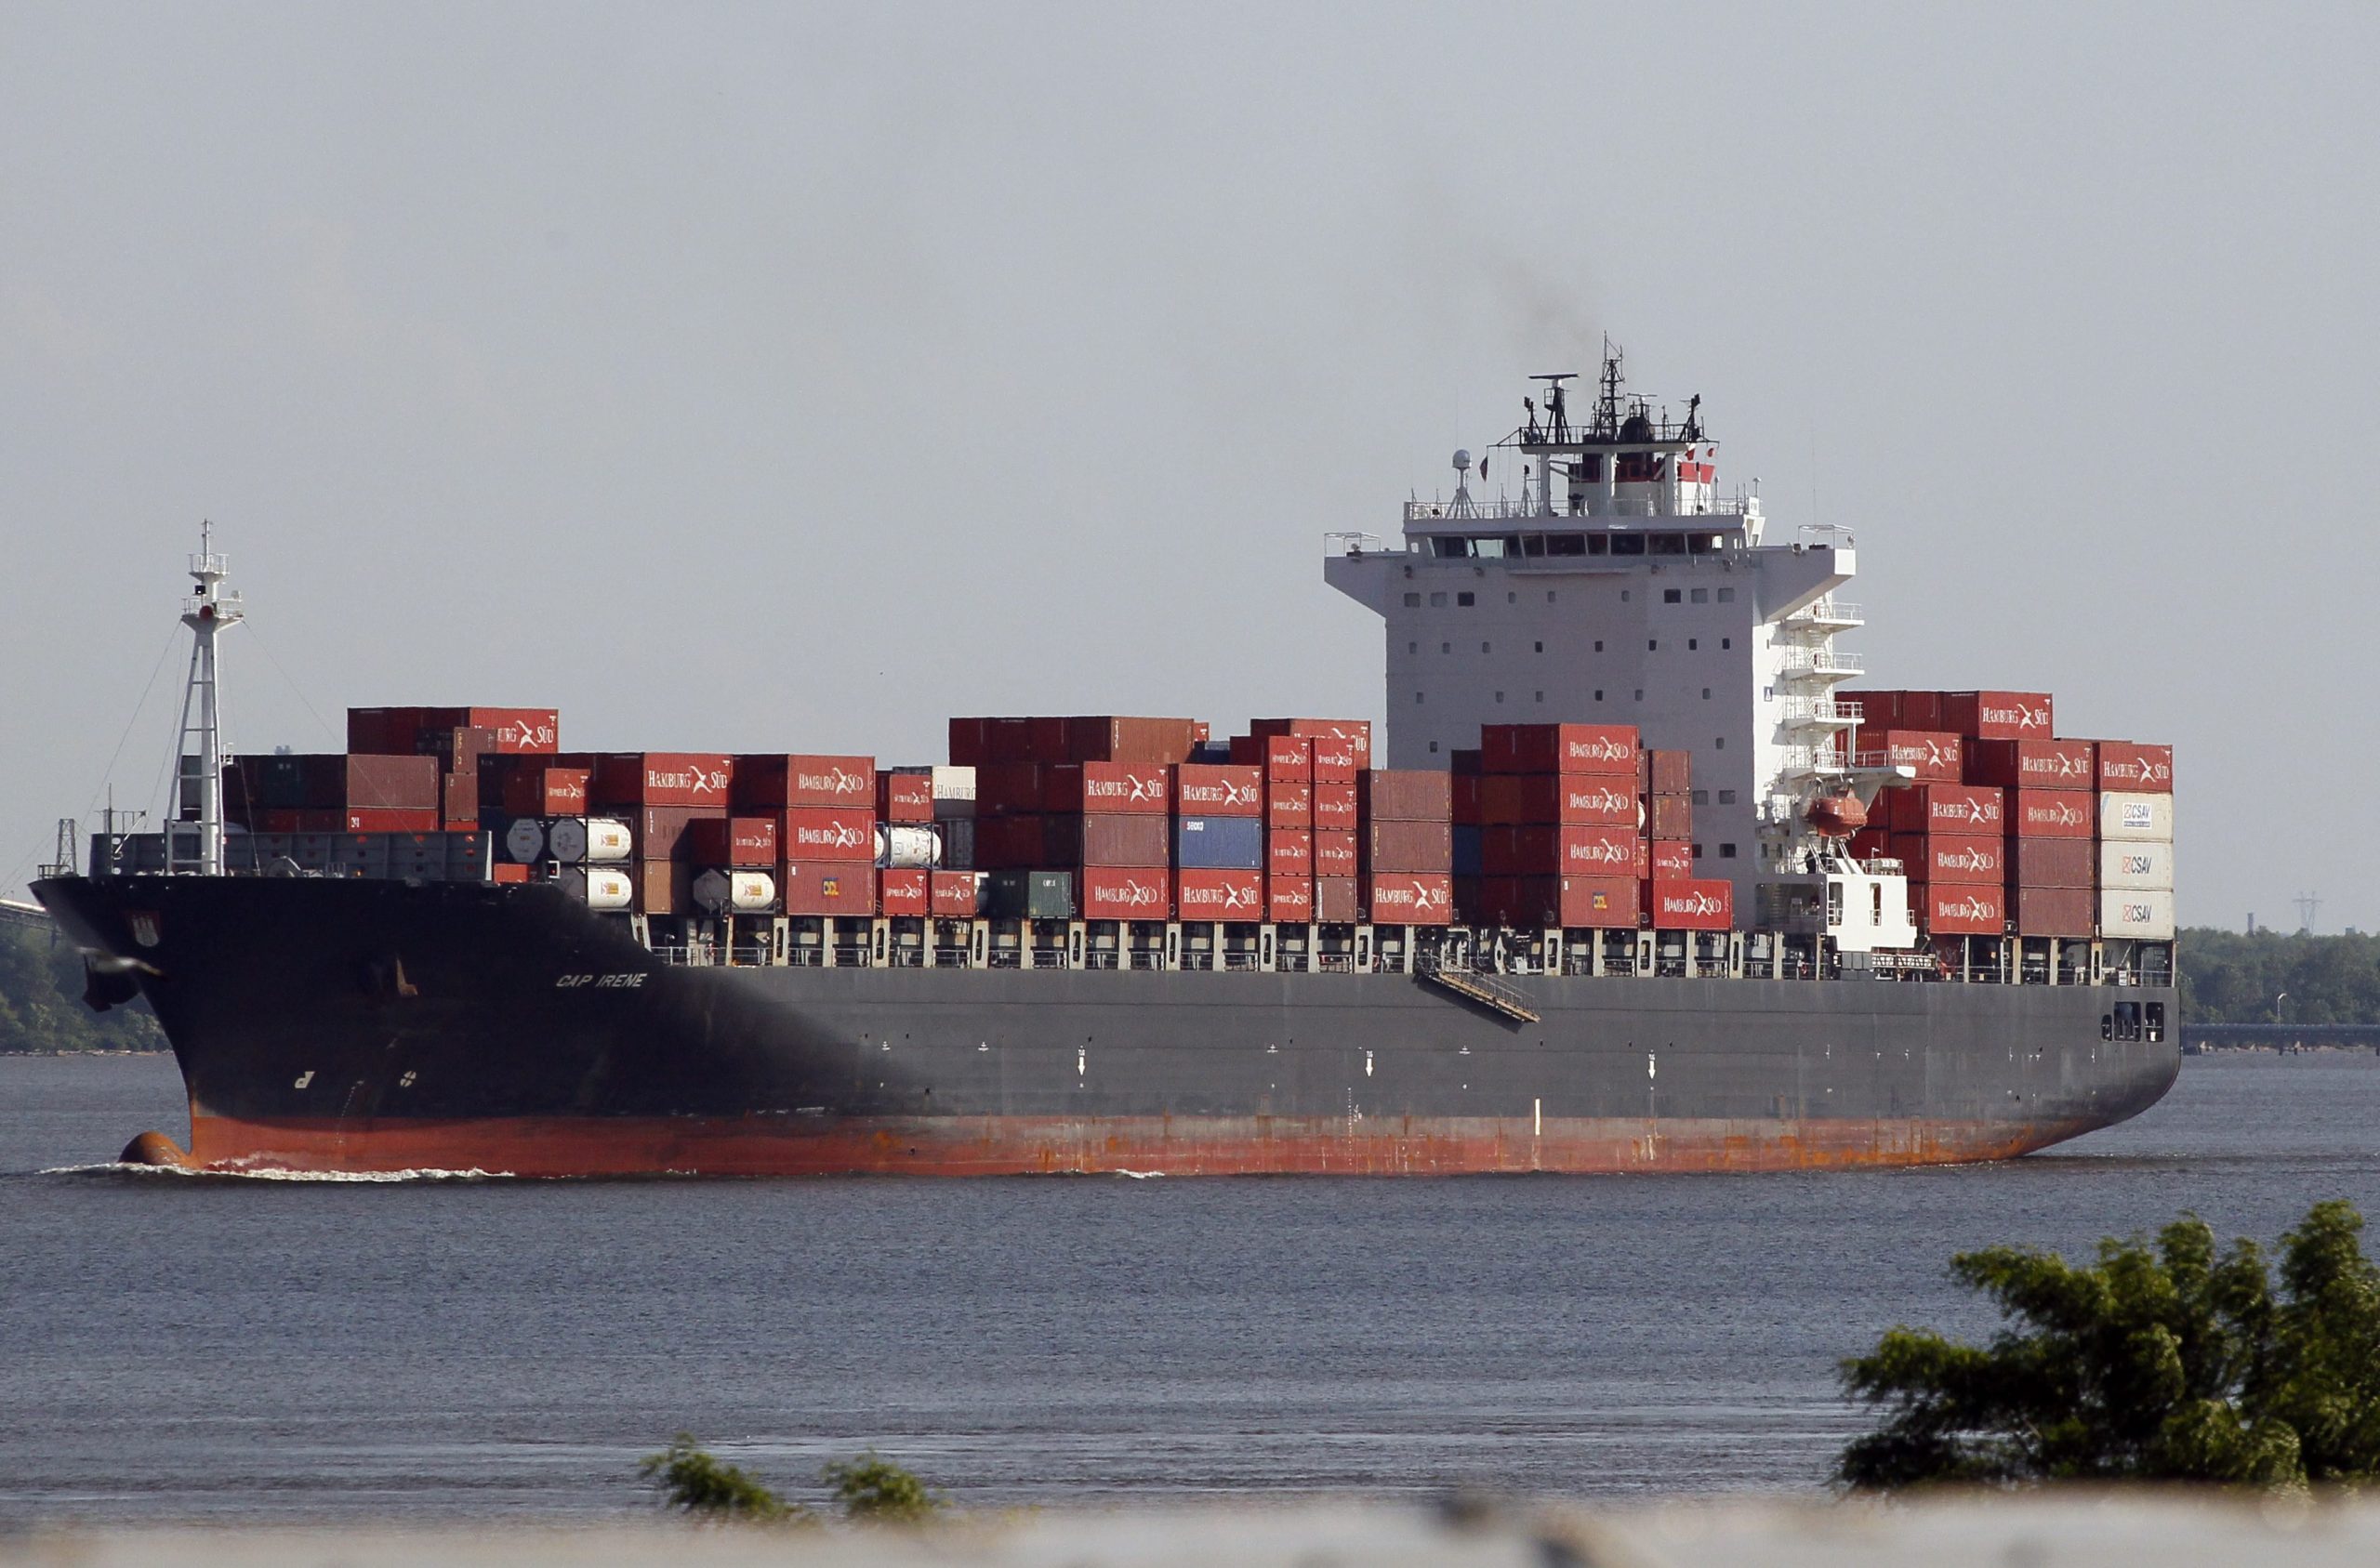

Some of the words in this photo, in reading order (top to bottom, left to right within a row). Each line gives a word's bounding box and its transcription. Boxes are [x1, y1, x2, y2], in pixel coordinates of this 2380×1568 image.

[1982, 706, 2018, 724] HAMBURG
[537, 727, 553, 744] SÜD
[2104, 761, 2138, 778] HAMBURG
[647, 770, 690, 788] HAMBURG
[710, 771, 726, 789] SÜD
[1088, 779, 1128, 797] HAMBURG
[1147, 778, 1163, 797] SÜD
[1183, 784, 1223, 801] HAMBURG
[1241, 784, 1257, 802] SÜD
[1932, 802, 1968, 819] HAMBURG
[2132, 804, 2150, 820] CSAV
[799, 827, 836, 844] HAMBURG
[2131, 856, 2152, 874] CSAV
[1183, 887, 1223, 903] HAMBURG
[1242, 887, 1257, 904] SÜD
[1375, 887, 1413, 904] HAMBURG
[2131, 904, 2152, 922] CSAV
[556, 974, 594, 988] CAP
[595, 973, 648, 988] IRENE
